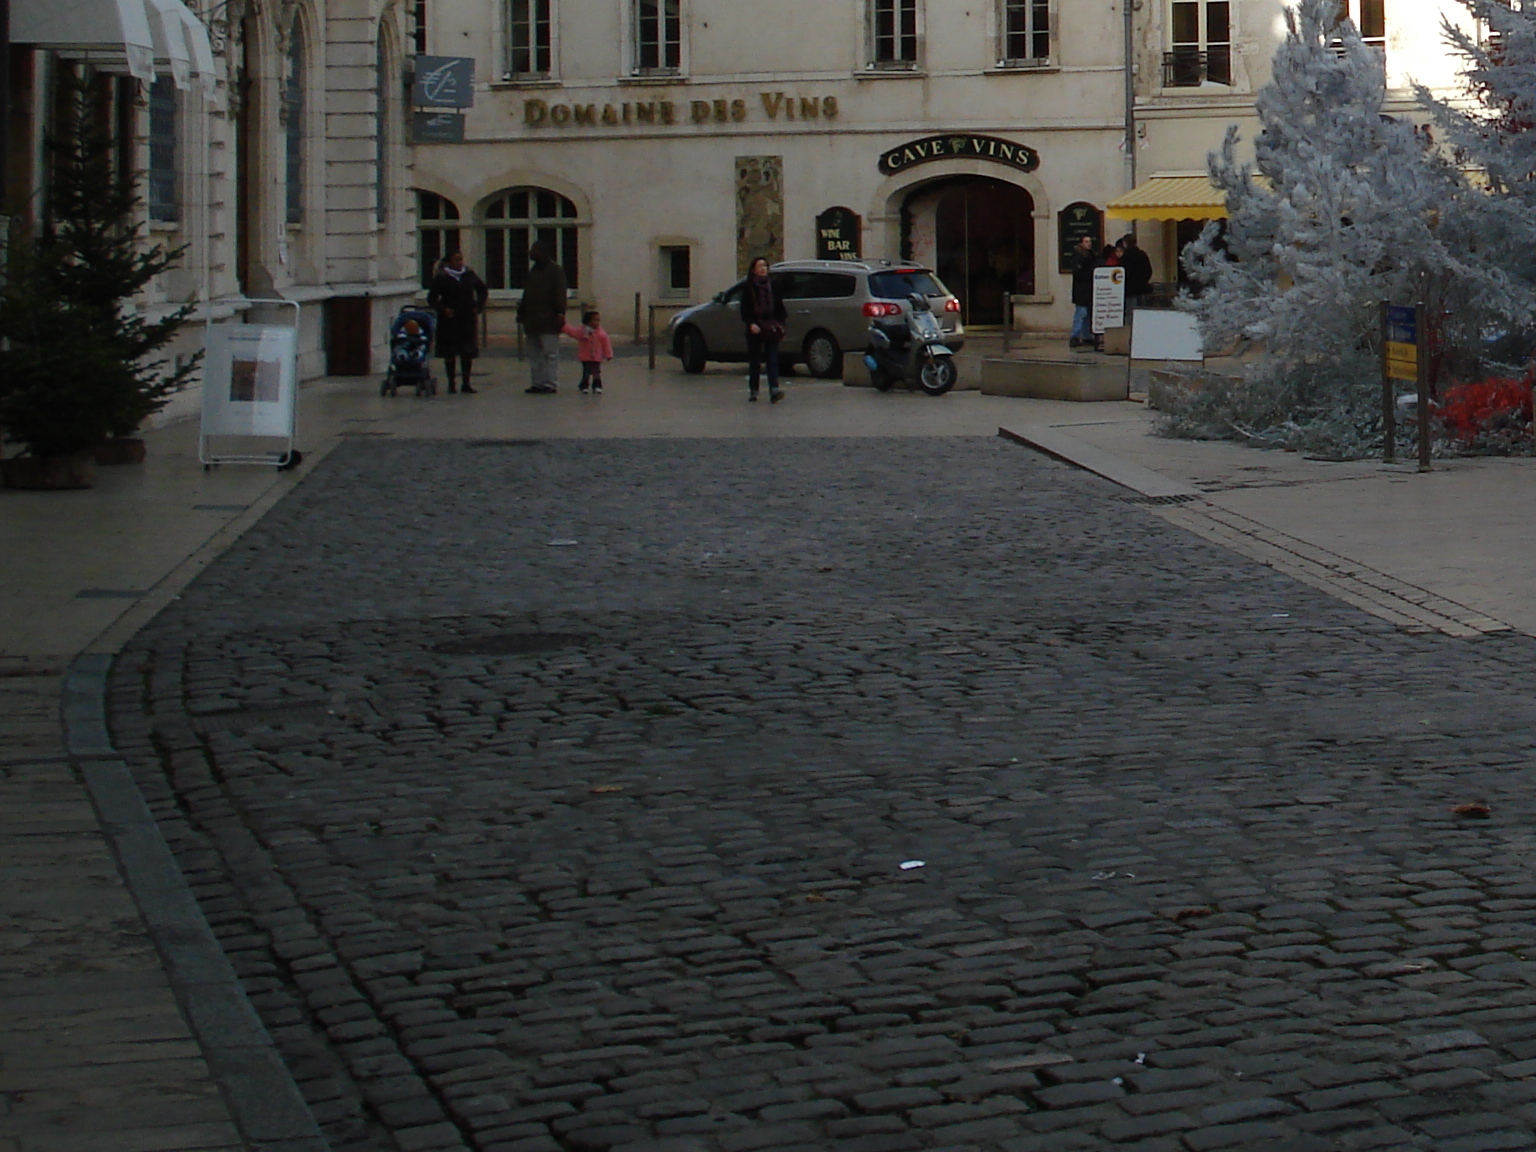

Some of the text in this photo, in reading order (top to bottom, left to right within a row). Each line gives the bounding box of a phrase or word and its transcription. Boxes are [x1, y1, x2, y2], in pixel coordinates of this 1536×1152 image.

[523, 91, 839, 126] DOMAINE DES VINS
[887, 138, 1030, 169] CAVE VINS
[827, 240, 851, 251] BAR
